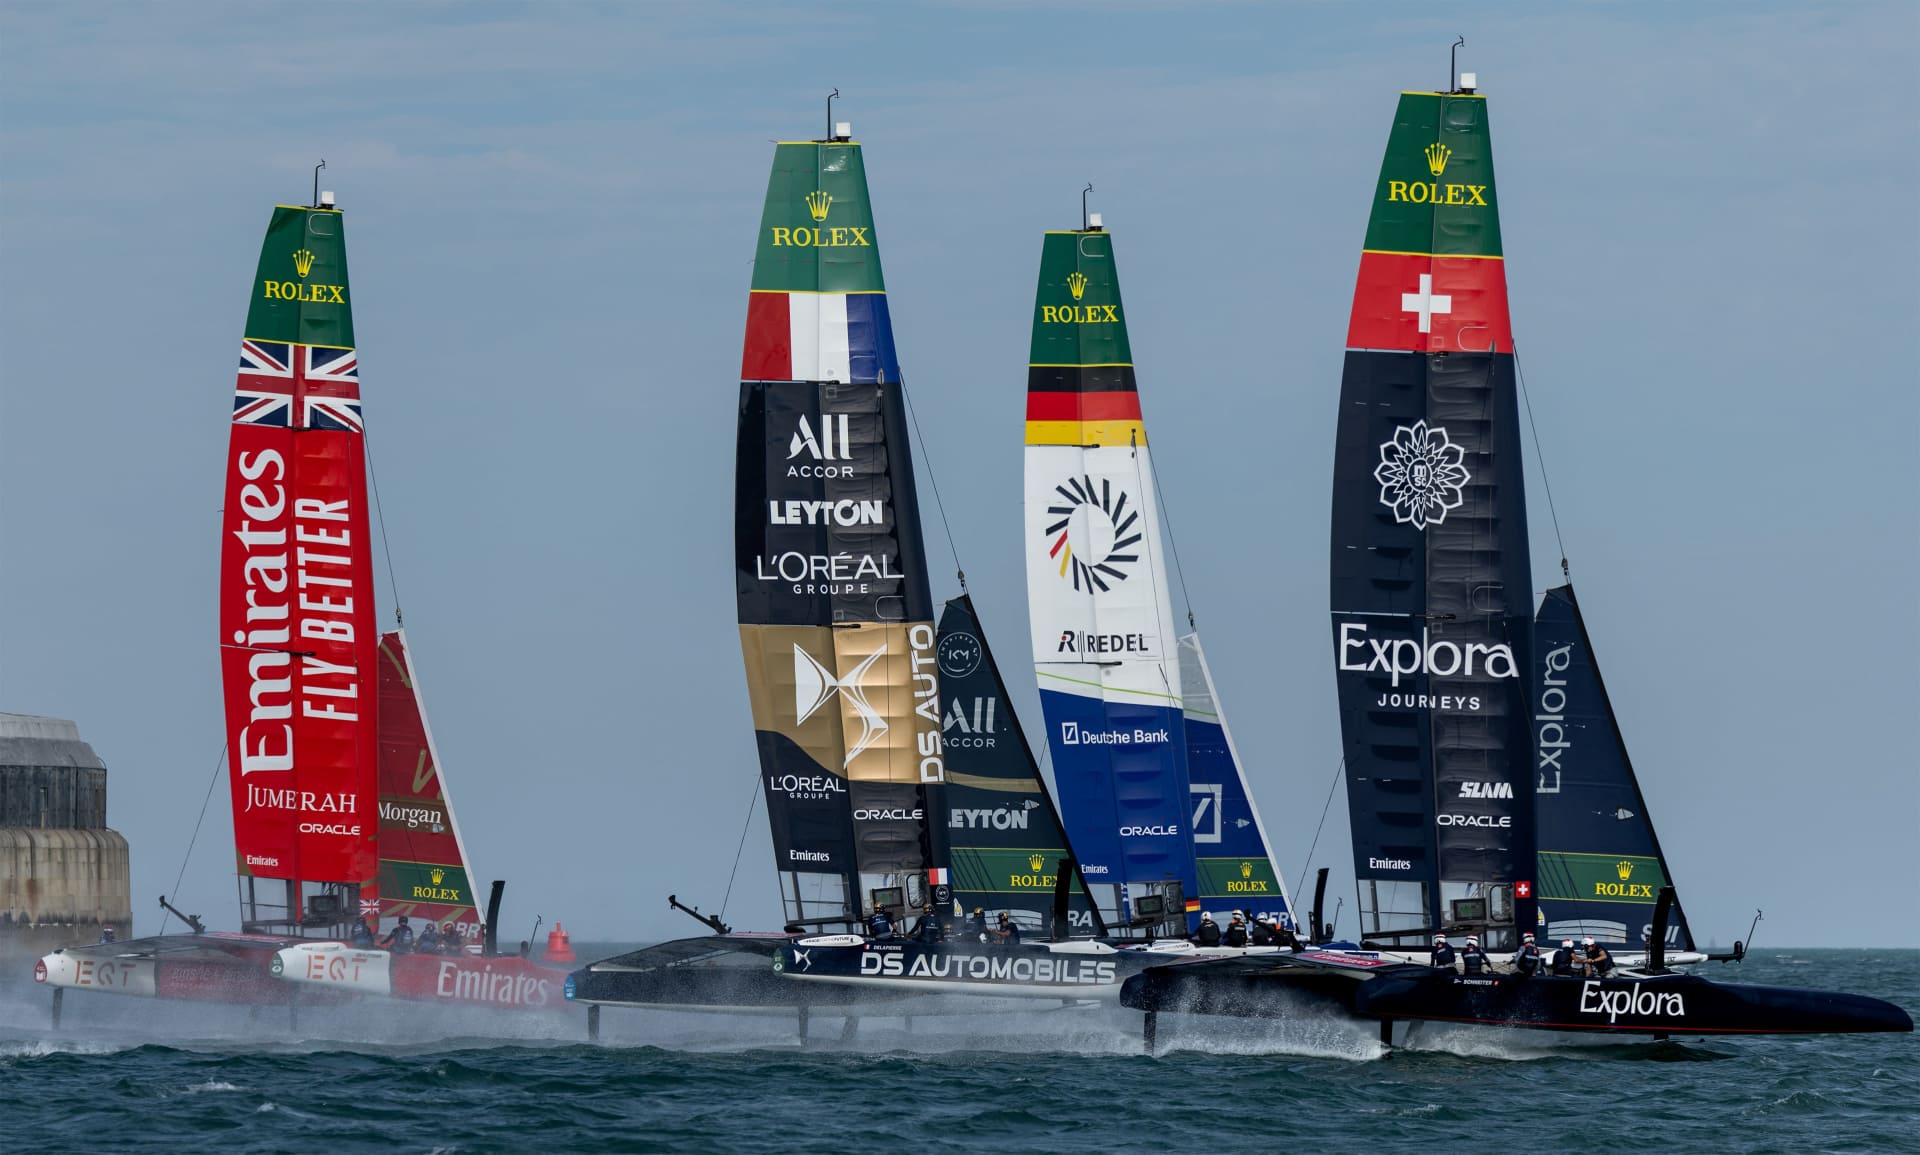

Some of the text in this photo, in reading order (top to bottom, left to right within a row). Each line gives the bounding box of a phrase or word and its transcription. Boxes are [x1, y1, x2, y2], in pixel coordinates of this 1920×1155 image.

[1388, 180, 1488, 206] ROLEX
[771, 226, 870, 247] ROLEX
[263, 280, 346, 304] ROLEX
[1042, 304, 1120, 323] ROLEX
[786, 465, 854, 479] ACCOR
[769, 498, 883, 527] LEYTON
[756, 551, 905, 582] L'ORÉAL
[792, 583, 869, 595] GROUPE
[233, 448, 295, 777] Emirates
[294, 497, 359, 722] FLY BETTER
[1087, 633, 1149, 653] REDEL
[1339, 622, 1520, 688] Explora
[909, 624, 945, 783] DS AUTO
[1377, 693, 1481, 711] JOURNEYS
[1535, 645, 1572, 794] Explora
[942, 737, 996, 748] ACCOR
[1134, 728, 1170, 744] Bank
[770, 774, 847, 793] L'ORÉAL
[1458, 782, 1514, 799] SLAM
[789, 792, 830, 800] GROUPE
[378, 801, 442, 828] Morgan
[853, 808, 923, 821] ORACLE
[949, 807, 1029, 831] EYTON
[1436, 814, 1512, 828] ORACLE
[299, 823, 361, 836] ORACLE
[1119, 825, 1178, 837] ORACLE
[246, 854, 279, 867] Emirates
[790, 849, 830, 863] Emirates
[1369, 857, 1411, 870] Emirates
[1081, 864, 1109, 874] Emirates
[412, 886, 460, 901] ROLEX
[1227, 880, 1268, 892] ROLEX
[1594, 882, 1653, 898] ROLEX
[1067, 910, 1093, 927] RA
[75, 959, 137, 987] EQT
[307, 954, 368, 982] EQT
[860, 951, 1116, 985] DS AUTOMOBILES
[436, 959, 549, 1006] Emirates
[1579, 980, 1686, 1024] Explora
